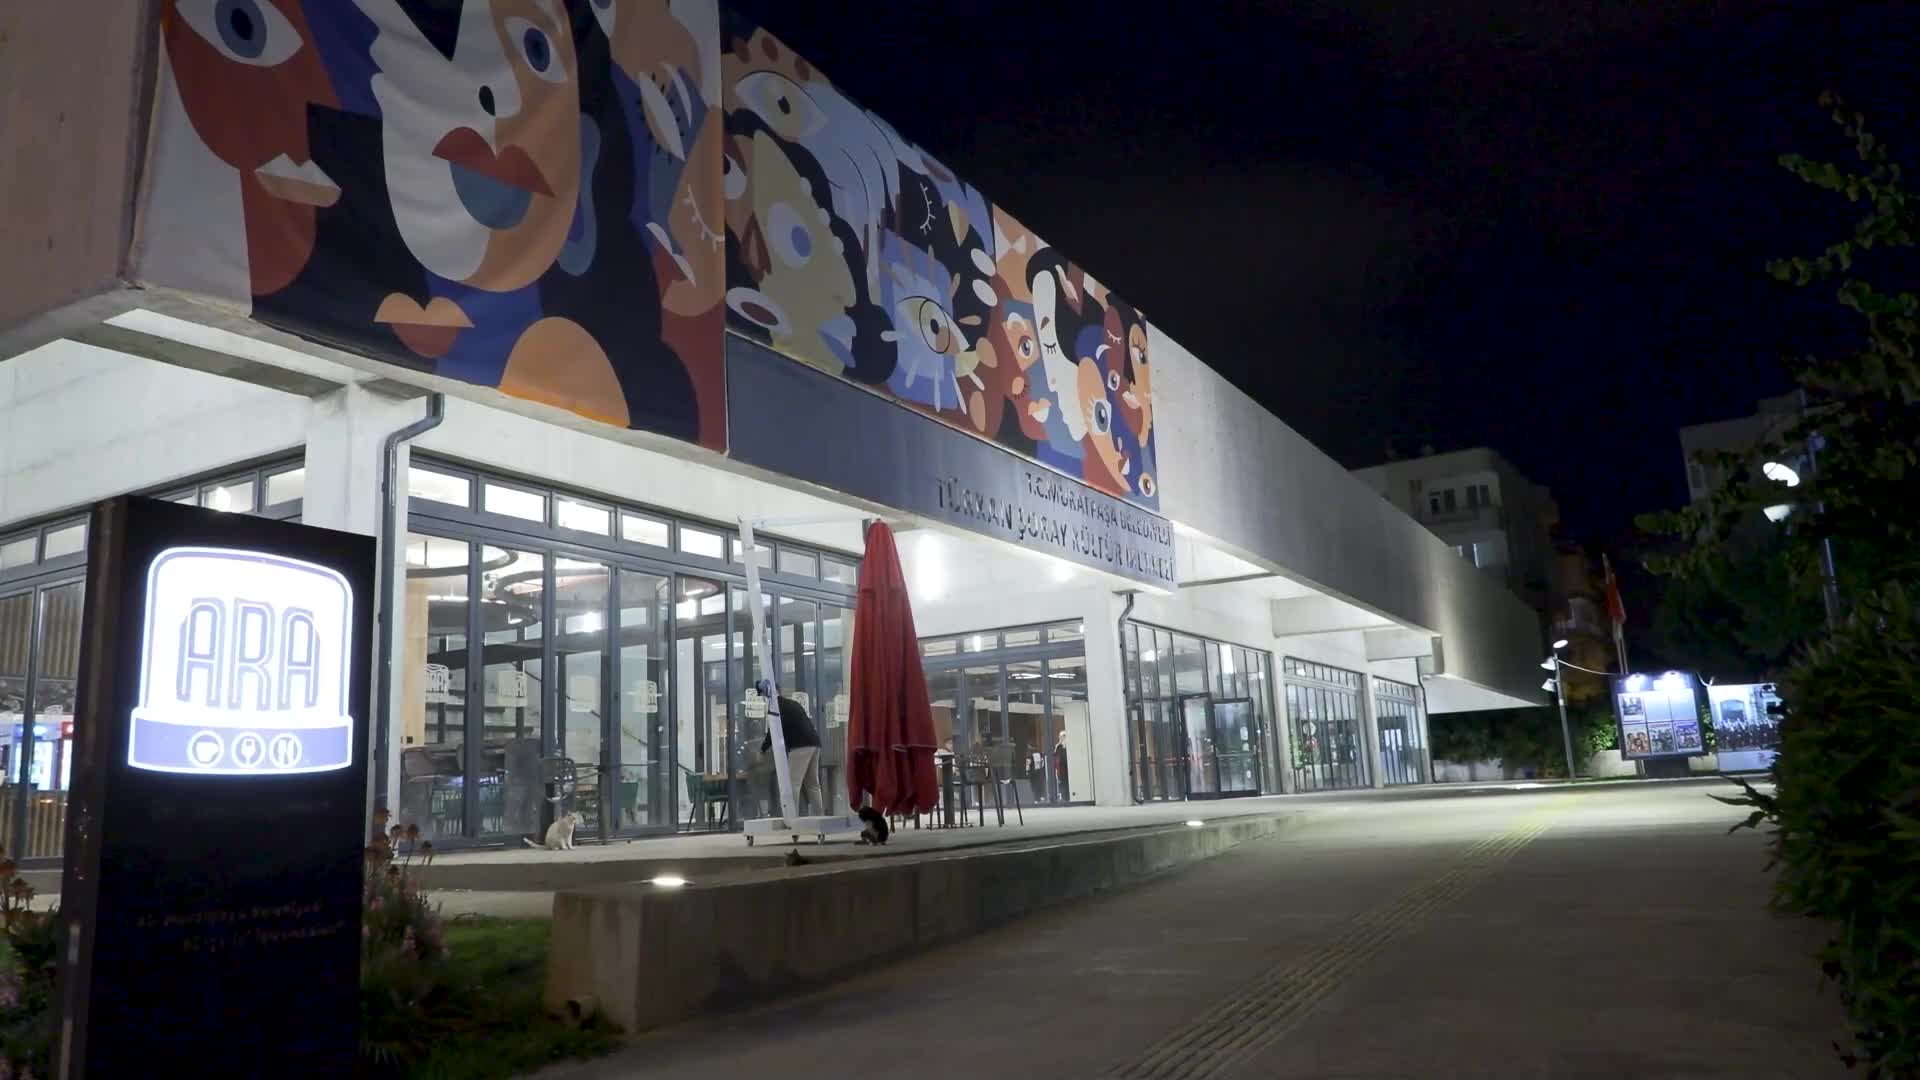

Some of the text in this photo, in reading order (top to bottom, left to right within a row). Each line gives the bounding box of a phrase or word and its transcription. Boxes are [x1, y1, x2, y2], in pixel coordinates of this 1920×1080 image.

[936, 478, 1012, 530] TÜRKAN
[1019, 506, 1067, 548] ŞORAY
[1072, 524, 1122, 566] KÜLTÜR
[176, 596, 320, 711] ARA
